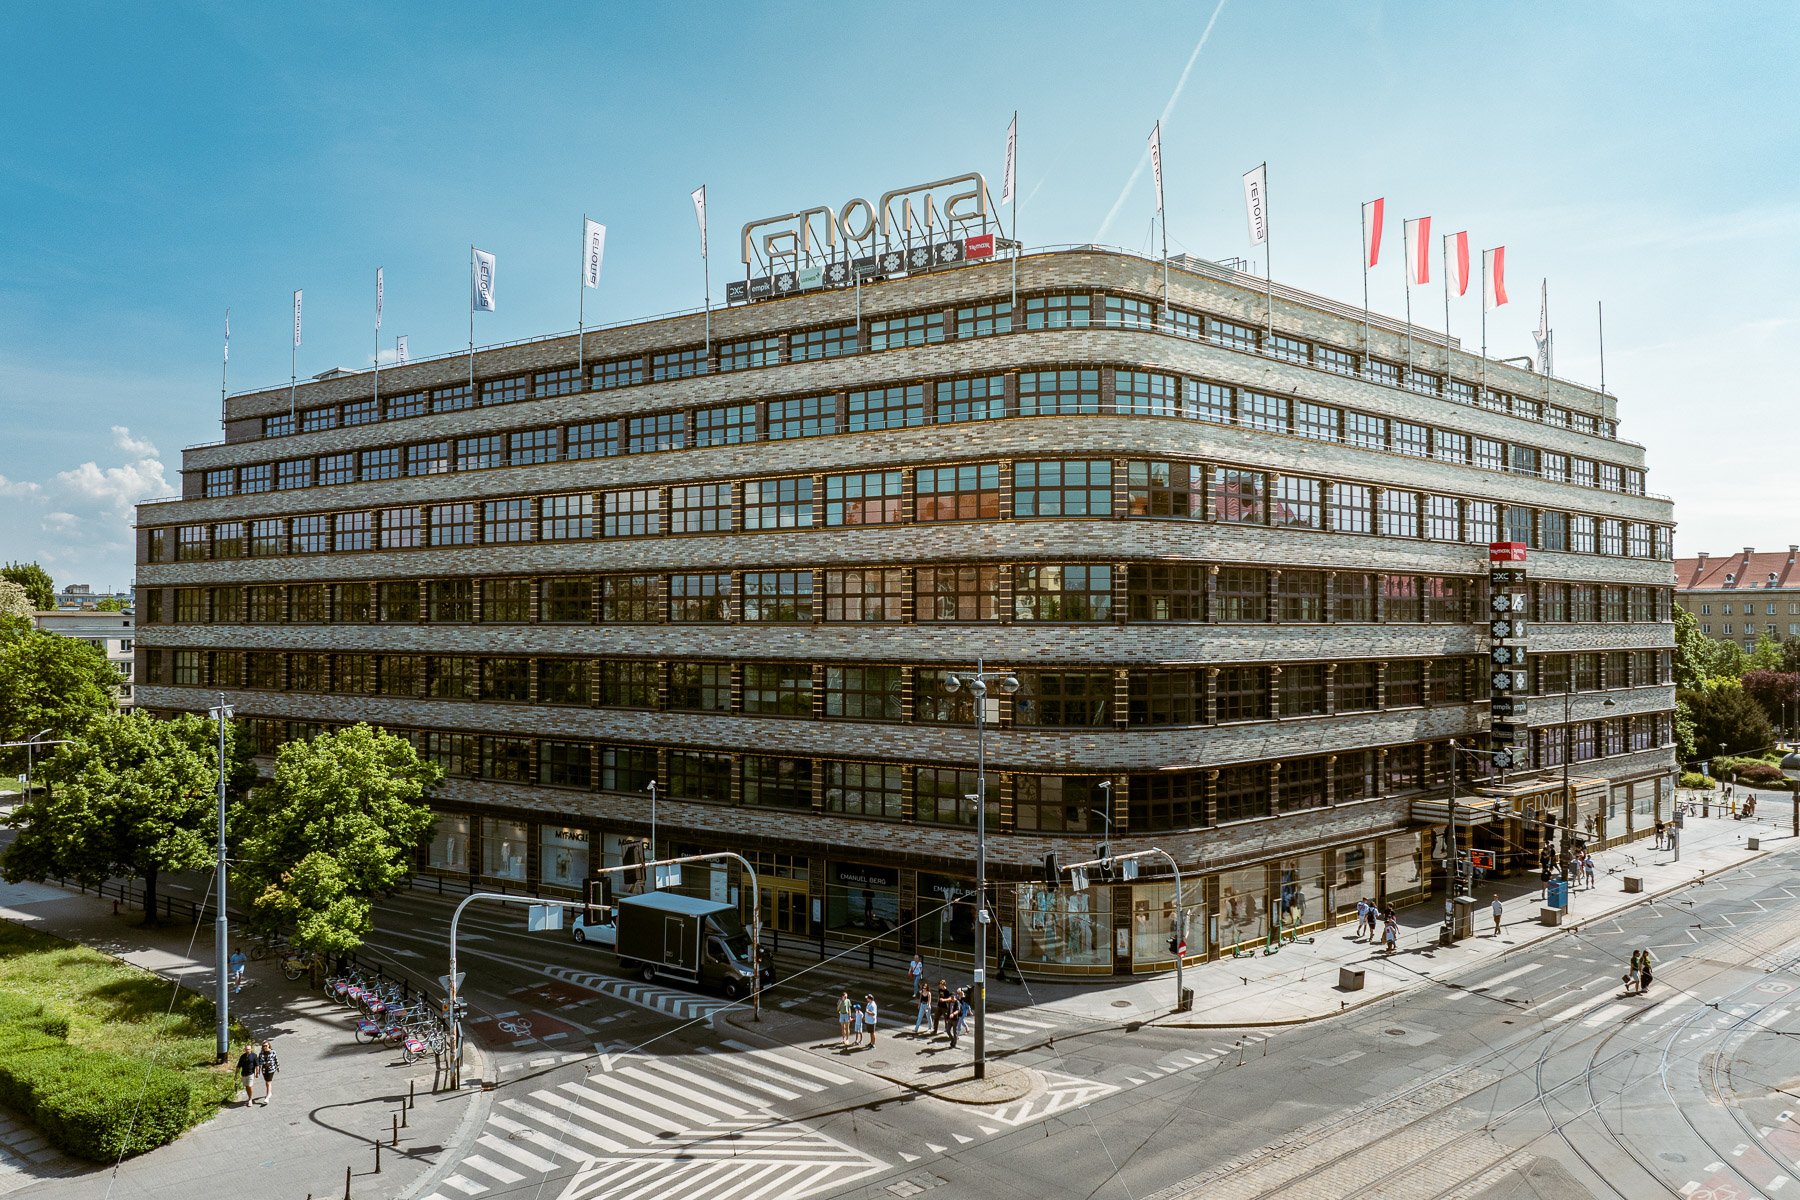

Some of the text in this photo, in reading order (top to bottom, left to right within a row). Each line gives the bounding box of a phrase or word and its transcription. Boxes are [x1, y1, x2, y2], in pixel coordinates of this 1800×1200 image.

[1250, 181, 1264, 240] renoma
[741, 172, 987, 263] renoma
[751, 283, 770, 293] empik
[1493, 703, 1511, 711] empik
[840, 873, 886, 885] EMANUEL BERG
